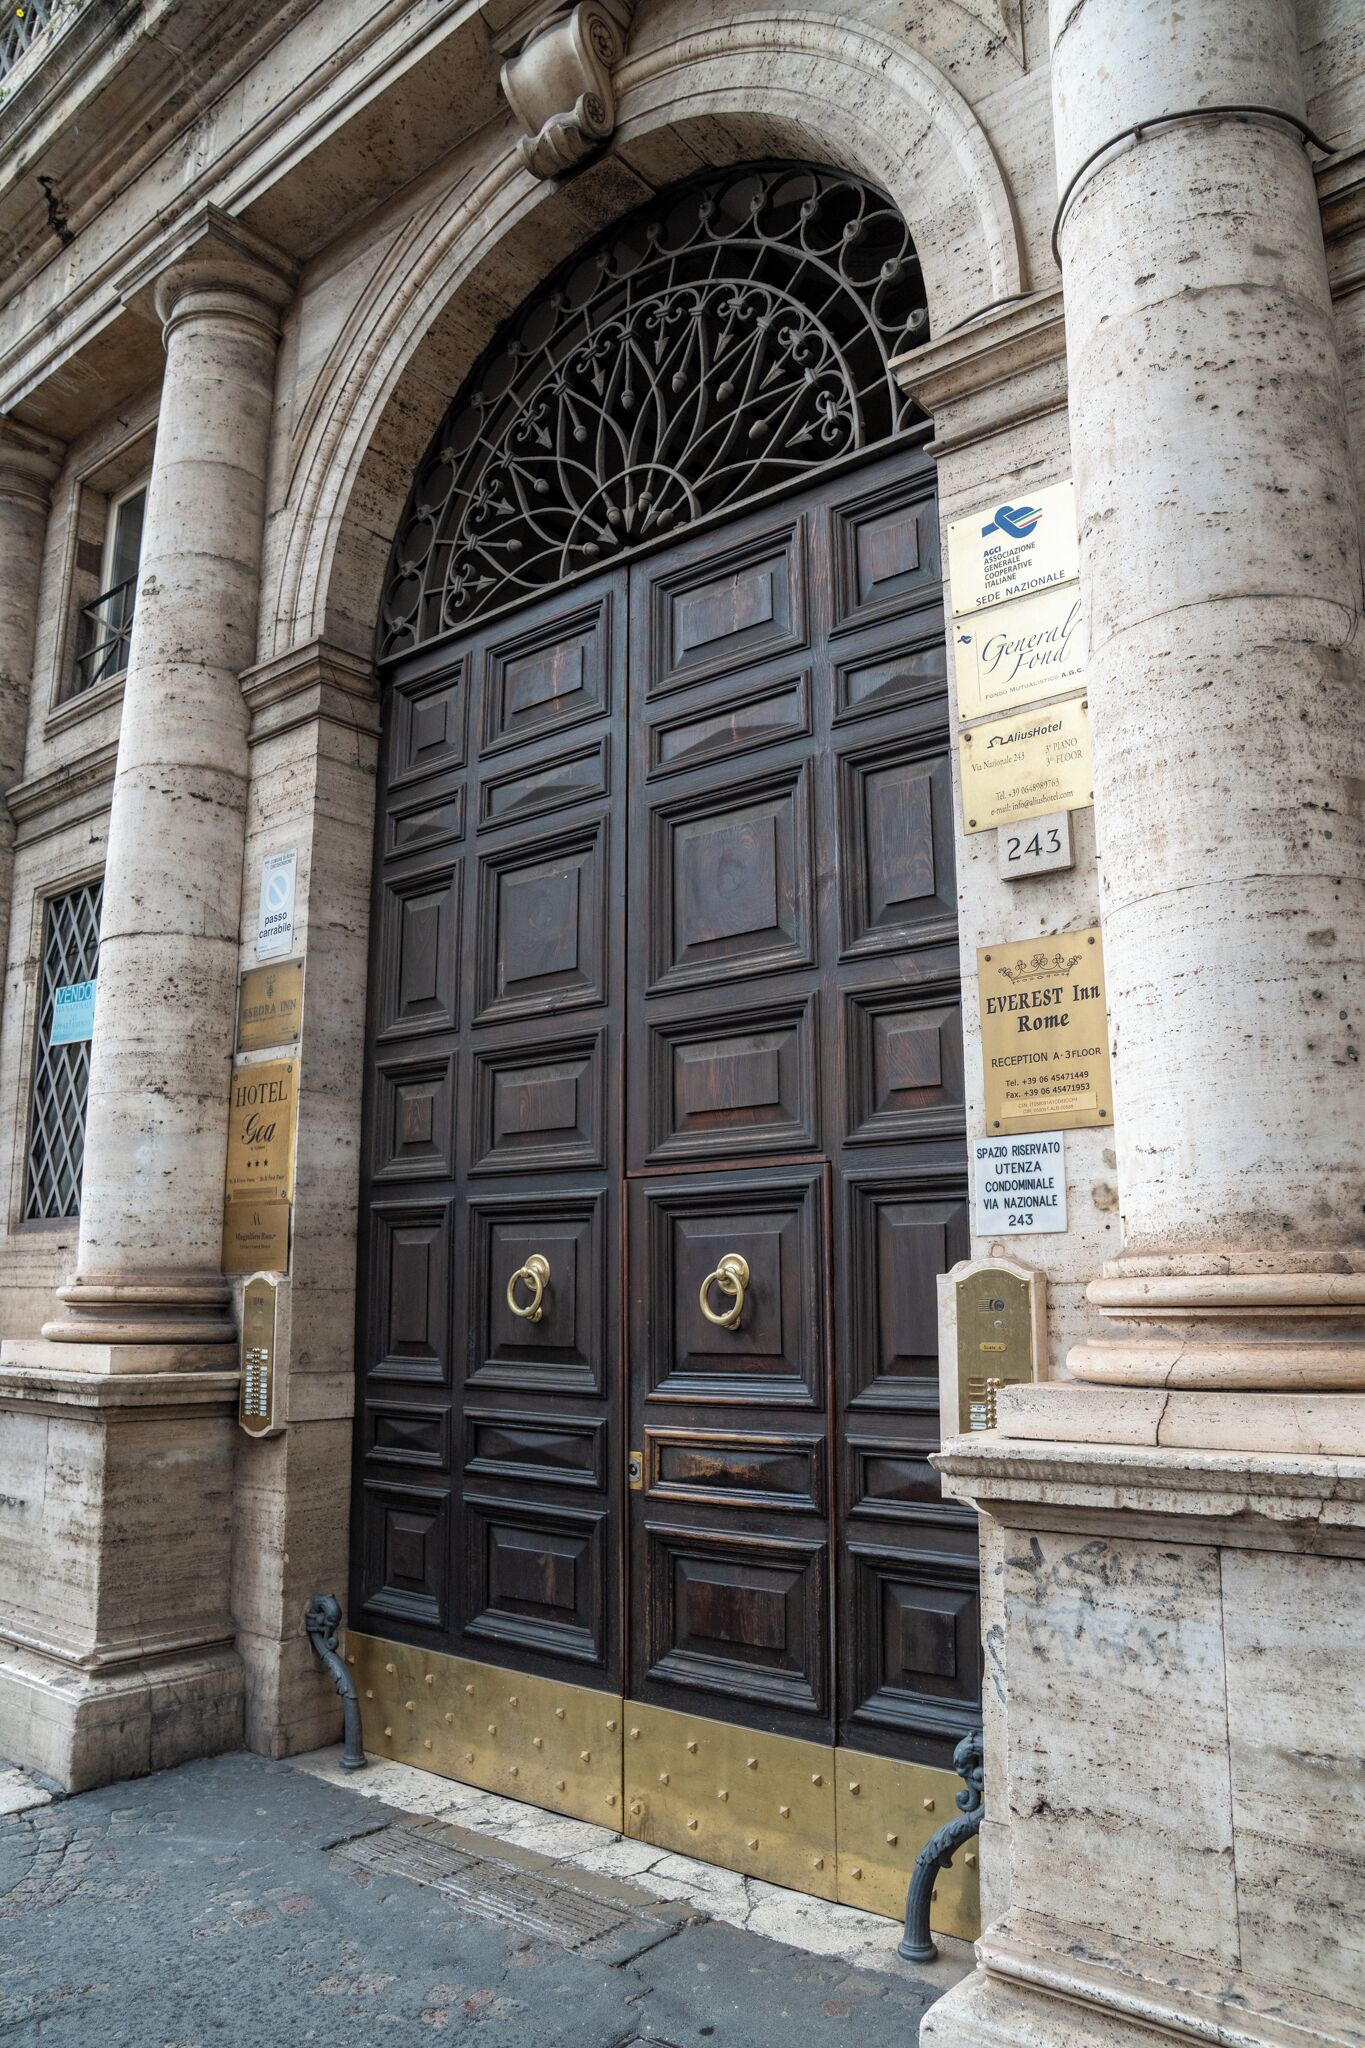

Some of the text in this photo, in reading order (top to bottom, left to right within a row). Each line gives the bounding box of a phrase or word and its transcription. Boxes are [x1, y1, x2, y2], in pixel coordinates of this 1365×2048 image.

[983, 545, 1002, 557] AGCI
[984, 542, 1036, 565] ASSOCIAZIONE
[984, 555, 1020, 573] GENERALE
[984, 559, 1033, 580] COOPERATIVE
[976, 569, 1066, 606] SEDE NAZIONALE
[985, 573, 1017, 589] ITALIANE
[982, 598, 1081, 675] General
[1001, 619, 1082, 684] Fond
[1007, 720, 1062, 743] AliusHotel
[1053, 737, 1078, 752] PIANO
[972, 752, 1025, 773] Via Nazionale 243
[1056, 749, 1083, 764] FLOOR
[995, 791, 1007, 801] Tel.
[1008, 788, 1020, 797] +39
[1007, 829, 1061, 861] 243
[264, 912, 287, 926] passo
[259, 923, 291, 939] carrabile
[58, 984, 92, 1003] VENDO
[986, 984, 1101, 1014] EVEREST Inn
[280, 999, 297, 1011] INN
[1017, 1012, 1070, 1032] Rome
[991, 1052, 1048, 1068] RECEPTION
[1006, 1070, 1089, 1087] Tel. +39 06 45471449
[236, 1081, 287, 1107] HOTEL
[1006, 1081, 1090, 1099] Fax. +39 06 45471953
[241, 1113, 276, 1145] Gea
[976, 1141, 1060, 1159] SPAZIO RISERVATO
[995, 1161, 1042, 1175] UTENZA
[985, 1177, 1054, 1193] CONDOMINIALE
[983, 1194, 1058, 1210] VIA NAZIONALE
[1008, 1213, 1033, 1227] 243
